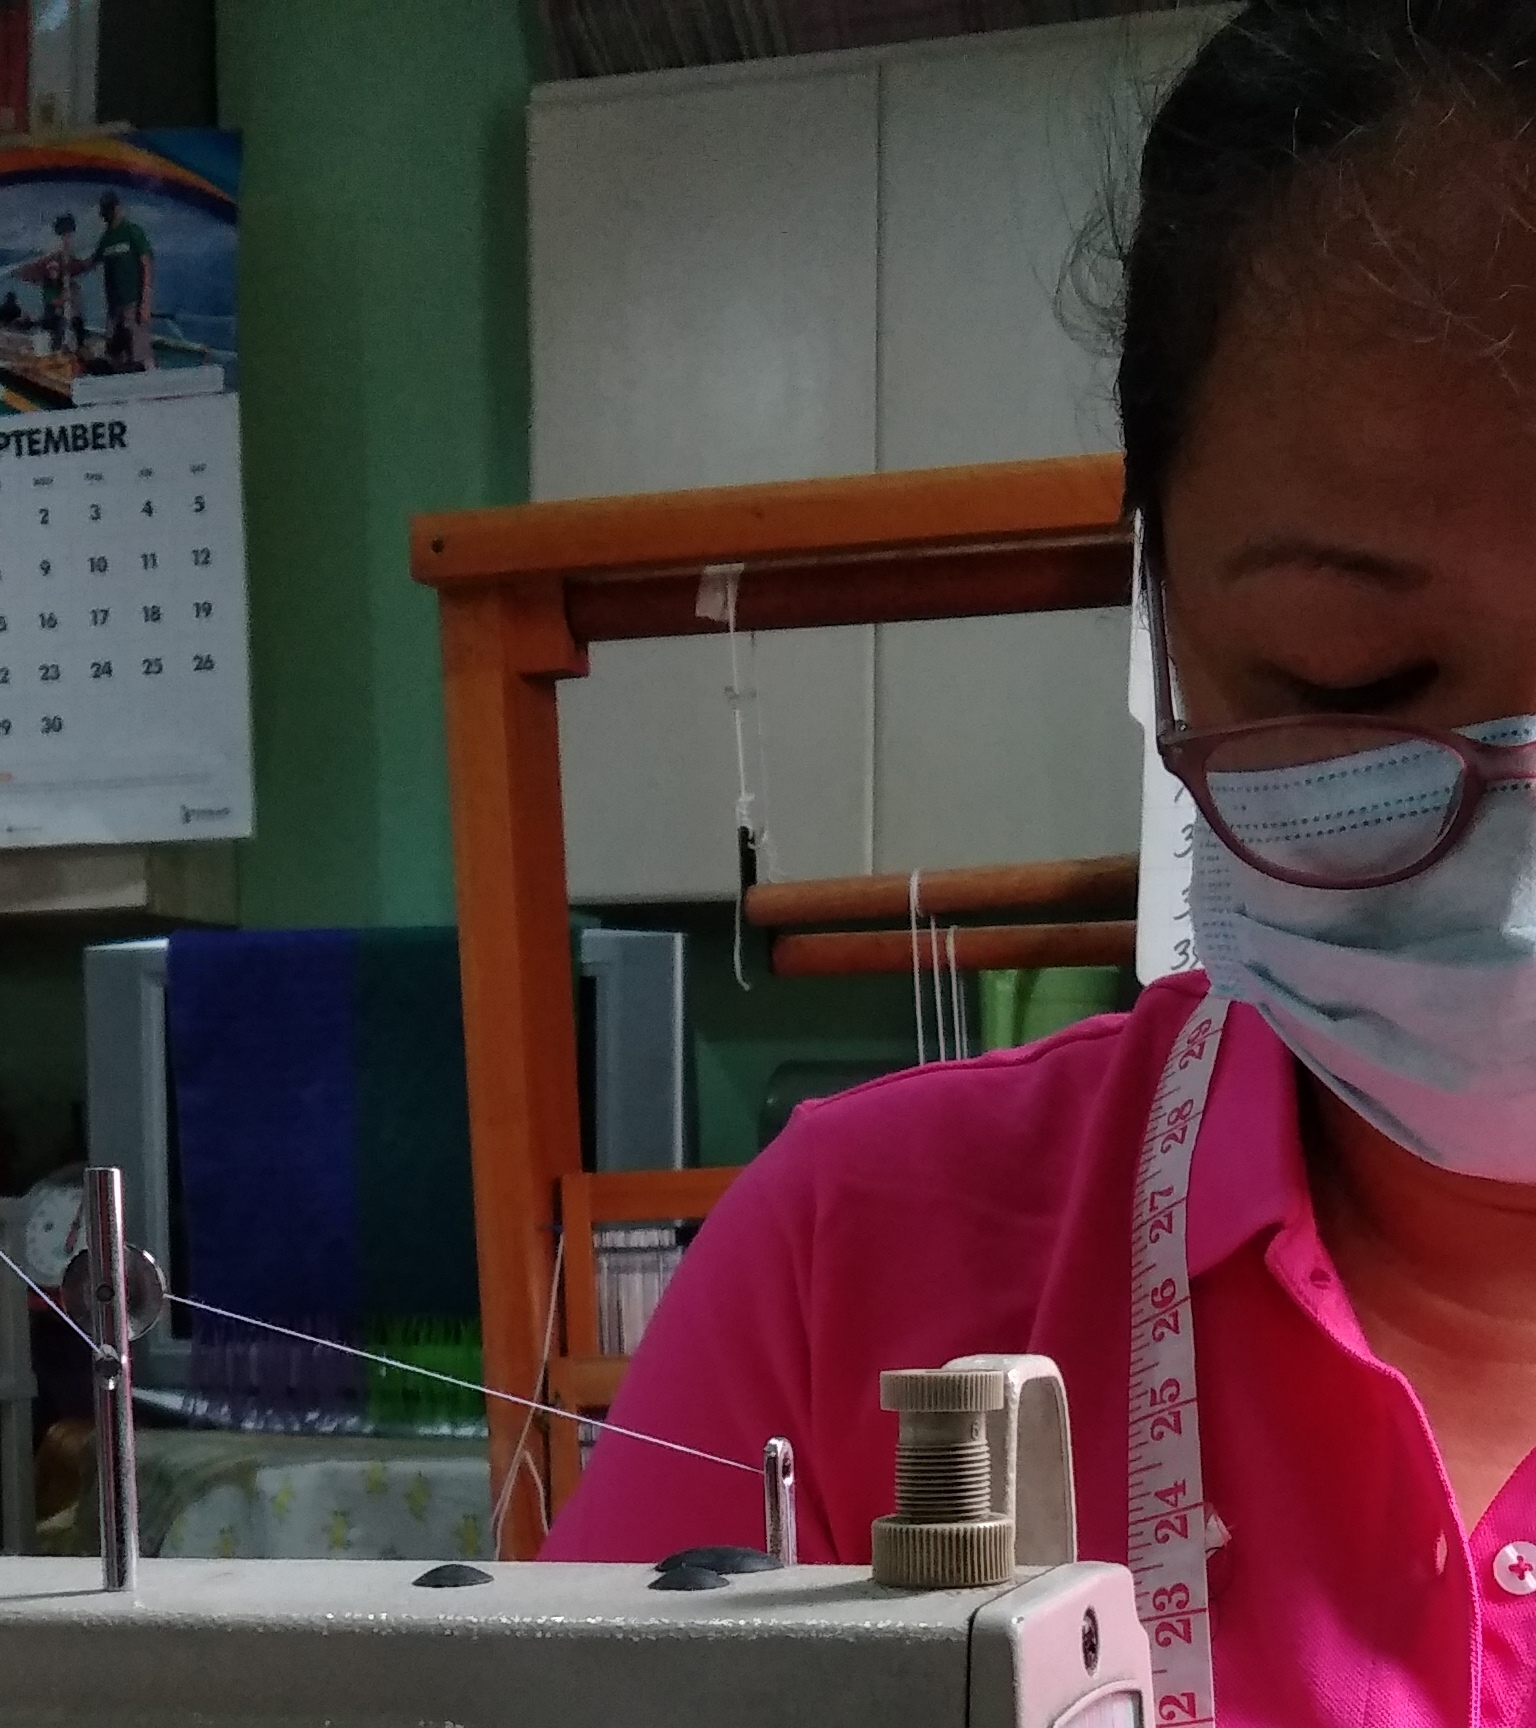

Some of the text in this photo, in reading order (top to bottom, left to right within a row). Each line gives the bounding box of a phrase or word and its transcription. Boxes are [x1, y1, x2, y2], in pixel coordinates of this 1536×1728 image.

[39, 509, 48, 524] 2
[91, 504, 101, 521] 3
[142, 501, 153, 516] 4
[195, 496, 205, 512] 5
[40, 560, 50, 576] 9
[89, 557, 108, 573] 10
[141, 553, 157, 570] 11
[192, 548, 210, 565] 12
[39, 613, 57, 628] 16
[91, 609, 109, 625] 17
[143, 606, 161, 622] 18
[194, 602, 212, 618] 19
[39, 665, 60, 681] 23
[91, 662, 112, 678] 24
[143, 658, 162, 675] 25
[194, 655, 214, 671] 26
[42, 716, 62, 733] 30
[1161, 1099, 1194, 1154] 28
[1149, 1186, 1175, 1243] 27
[1151, 1278, 1179, 1342] 26
[1149, 1377, 1182, 1442] 25
[1154, 1479, 1189, 1544] 24
[1152, 1582, 1192, 1648] 23
